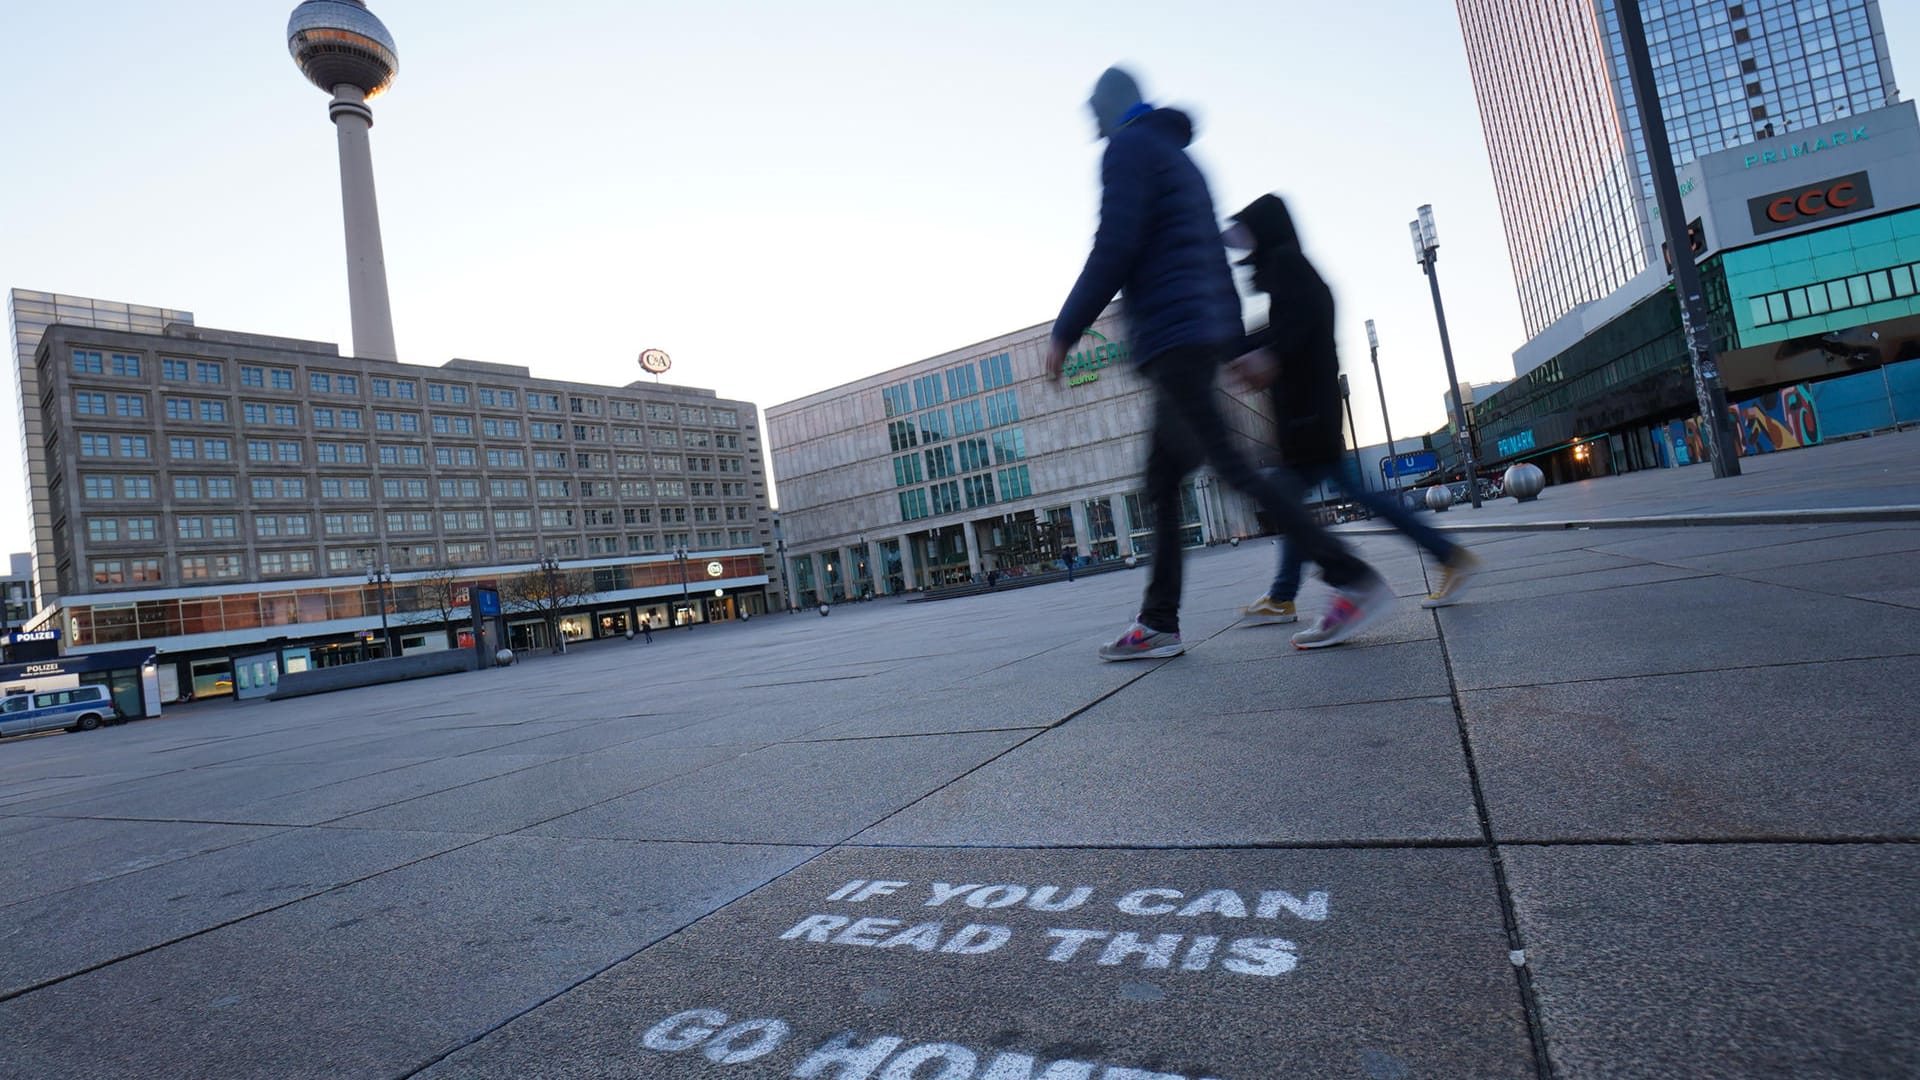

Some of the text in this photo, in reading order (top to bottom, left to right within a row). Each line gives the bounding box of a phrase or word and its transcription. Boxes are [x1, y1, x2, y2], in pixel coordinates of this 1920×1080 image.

[1744, 126, 1869, 169] PRIMARK
[1767, 182, 1857, 222] CCC
[646, 353, 667, 367] C&A
[1406, 457, 1415, 467] U
[17, 631, 54, 642] POLIZEI
[26, 663, 59, 673] POLIZEI
[826, 879, 1329, 921] IF YOU CAN
[780, 914, 1299, 977] READ THIS
[642, 1007, 792, 1064] GO
